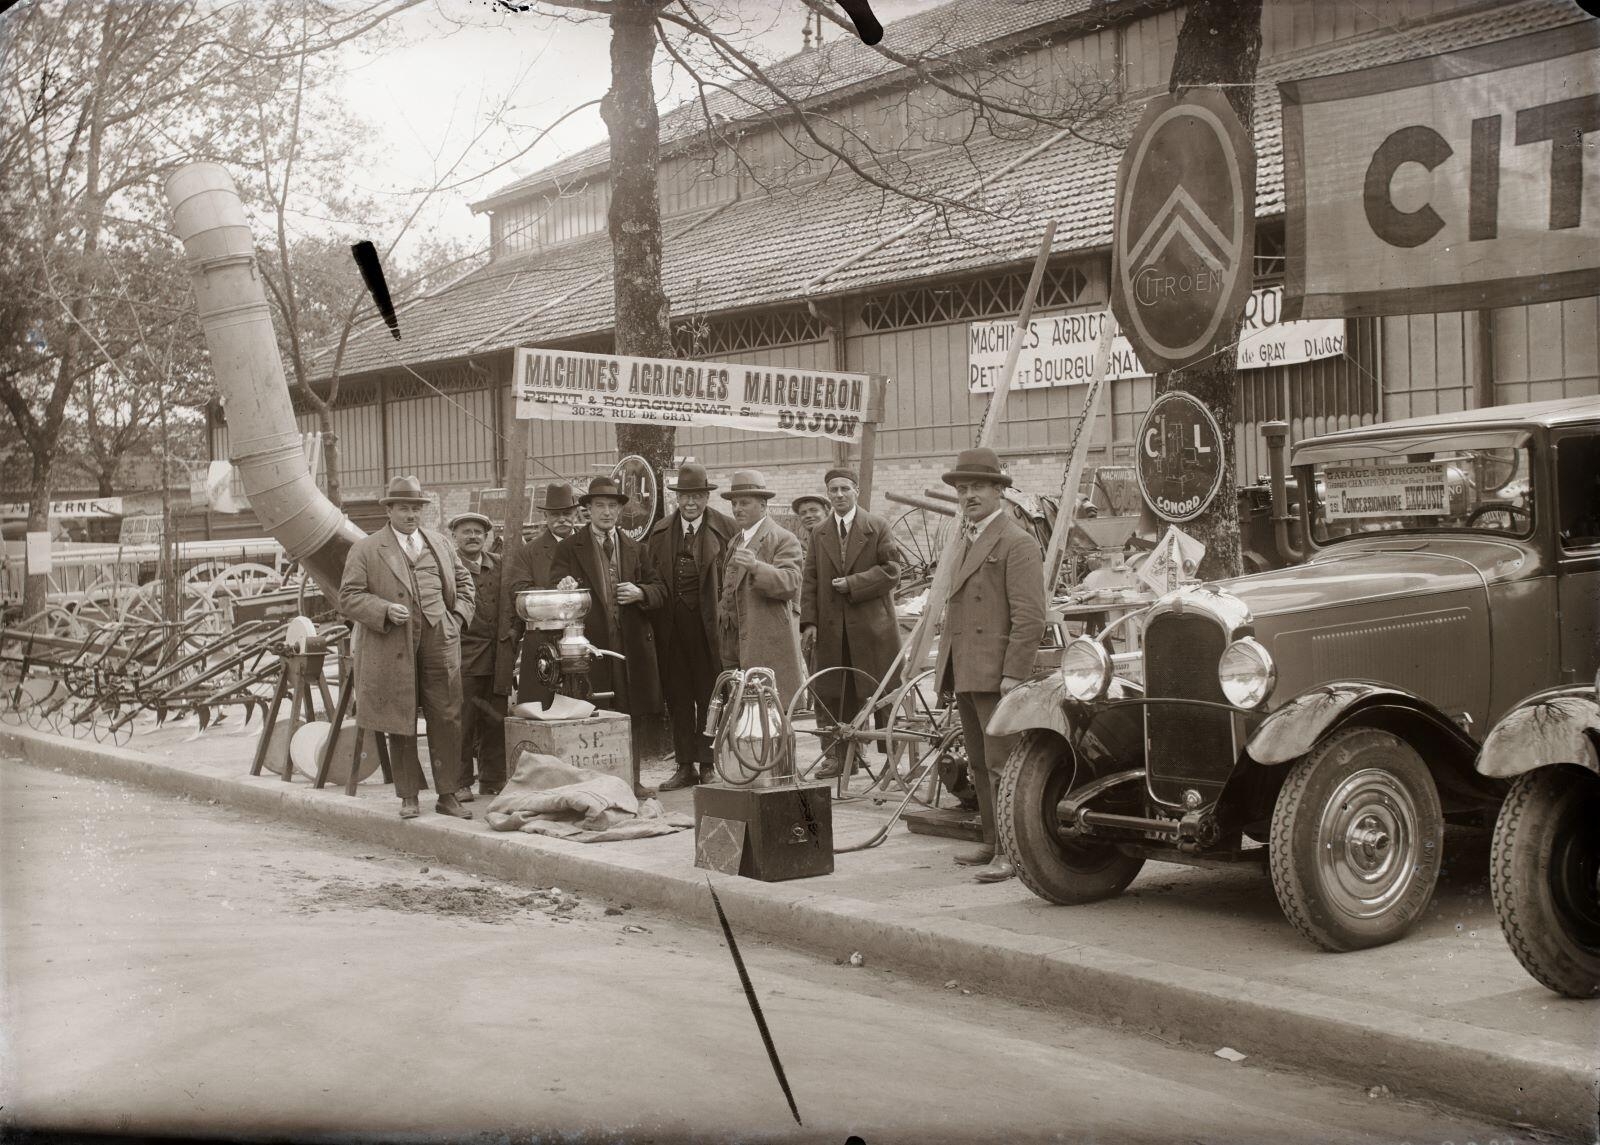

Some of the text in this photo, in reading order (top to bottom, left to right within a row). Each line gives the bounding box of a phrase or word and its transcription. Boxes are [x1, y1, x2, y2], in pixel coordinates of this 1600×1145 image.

[970, 322, 1040, 354] MACHIS
[1259, 341, 1286, 361] GRAY
[1304, 336, 1344, 357] DIJON
[524, 354, 864, 413] MACHINES AGRICOLES MARGUERON
[1018, 370, 1030, 384] ET
[523, 390, 582, 405] PETIT
[588, 395, 598, 405] &
[611, 409, 636, 419] RUE
[641, 411, 657, 420] DE
[662, 412, 693, 422] GRAY
[777, 409, 860, 438] DIJON
[1157, 495, 1200, 514] CONORD
